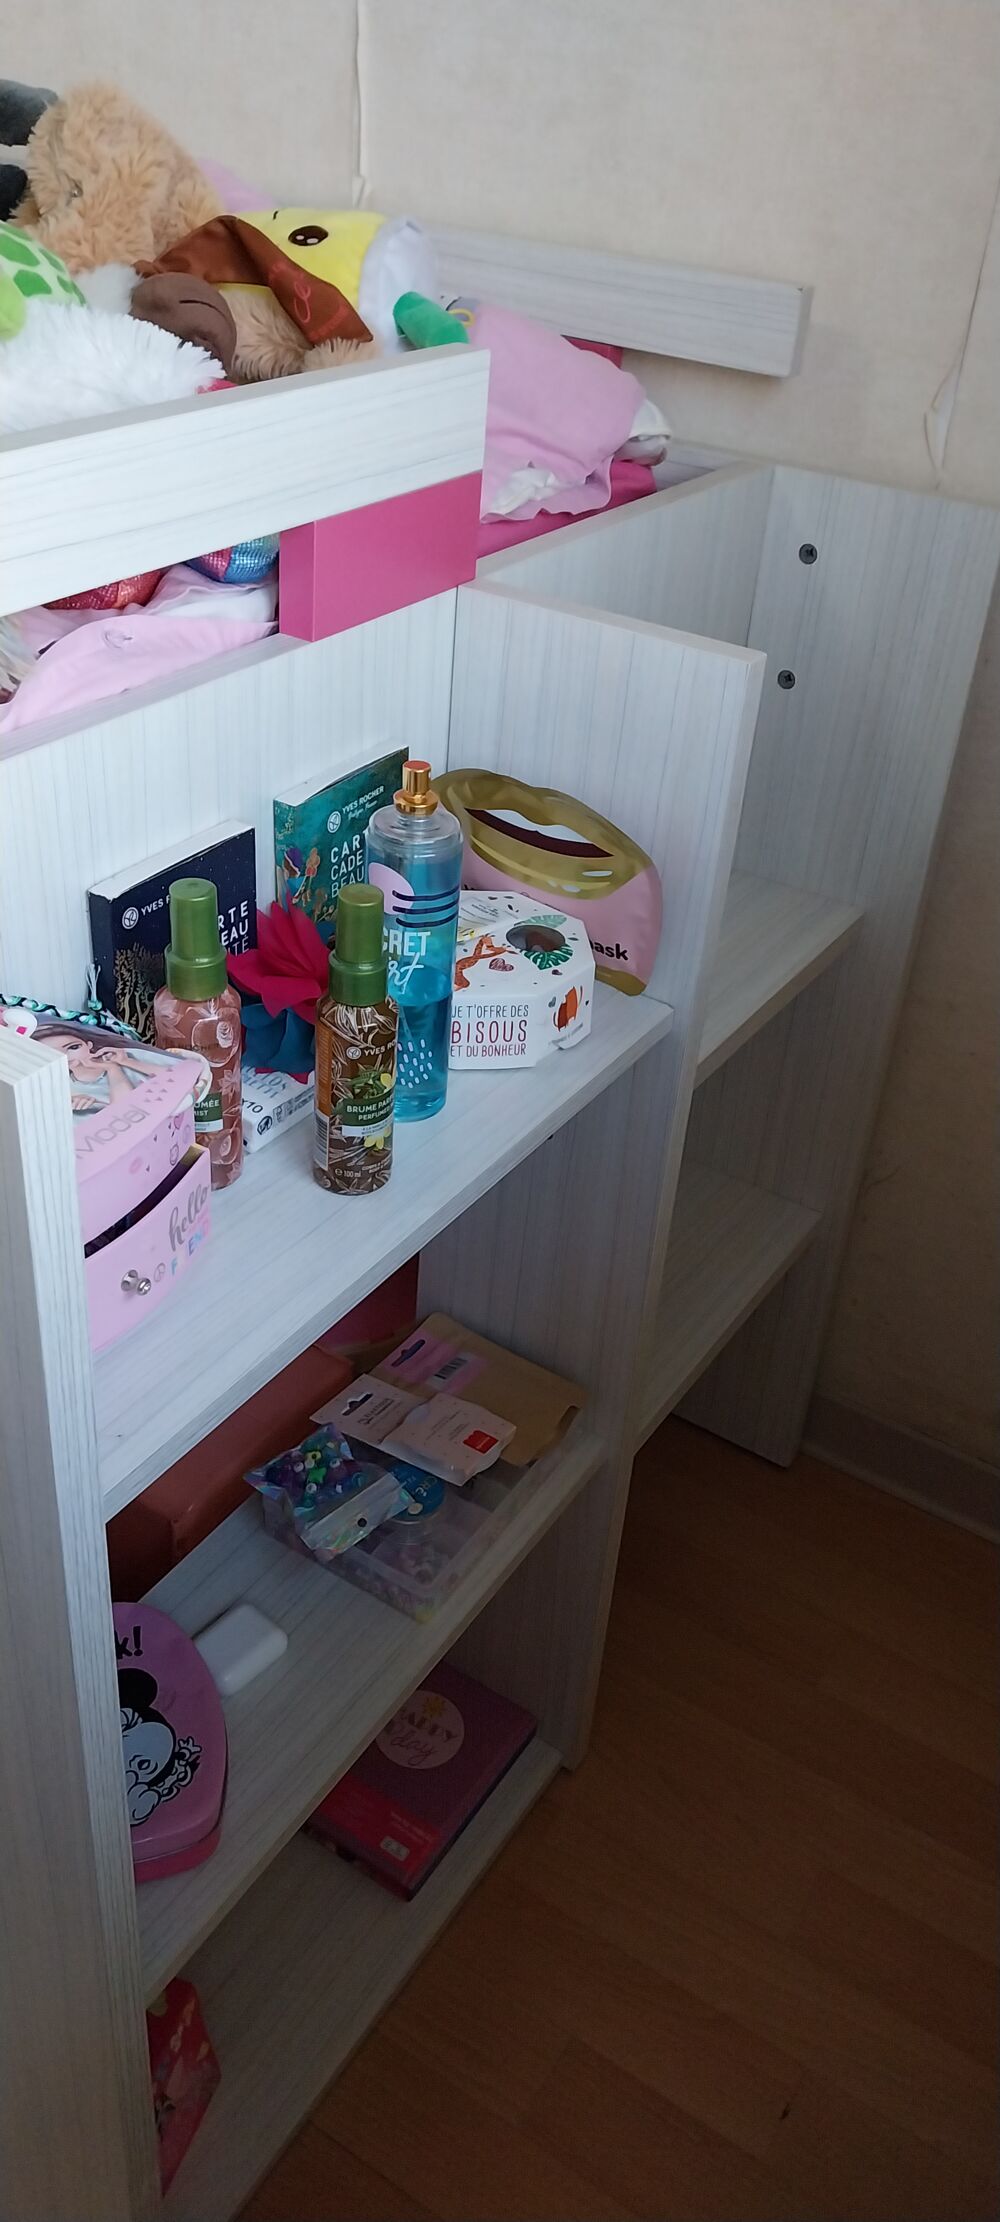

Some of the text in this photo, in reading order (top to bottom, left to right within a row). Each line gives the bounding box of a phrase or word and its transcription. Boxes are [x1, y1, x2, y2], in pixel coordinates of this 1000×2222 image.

[342, 800, 358, 814] YVES
[359, 785, 384, 804] ROCHER
[331, 829, 368, 863] CAR
[331, 849, 364, 880] CADE
[332, 866, 364, 898] BEAU
[141, 899, 164, 916] YVES
[218, 900, 248, 930] RTE
[221, 919, 248, 946] EAU
[590, 940, 628, 960] ask
[467, 1004, 507, 1018] T'OFFRE
[511, 1005, 529, 1018] DES
[451, 1020, 527, 1044] BISOUS
[364, 1046, 385, 1056] YVES
[451, 1043, 526, 1057] ET DU BONHEUR
[347, 1104, 377, 1113] BRUME
[169, 1184, 209, 1252] hello
